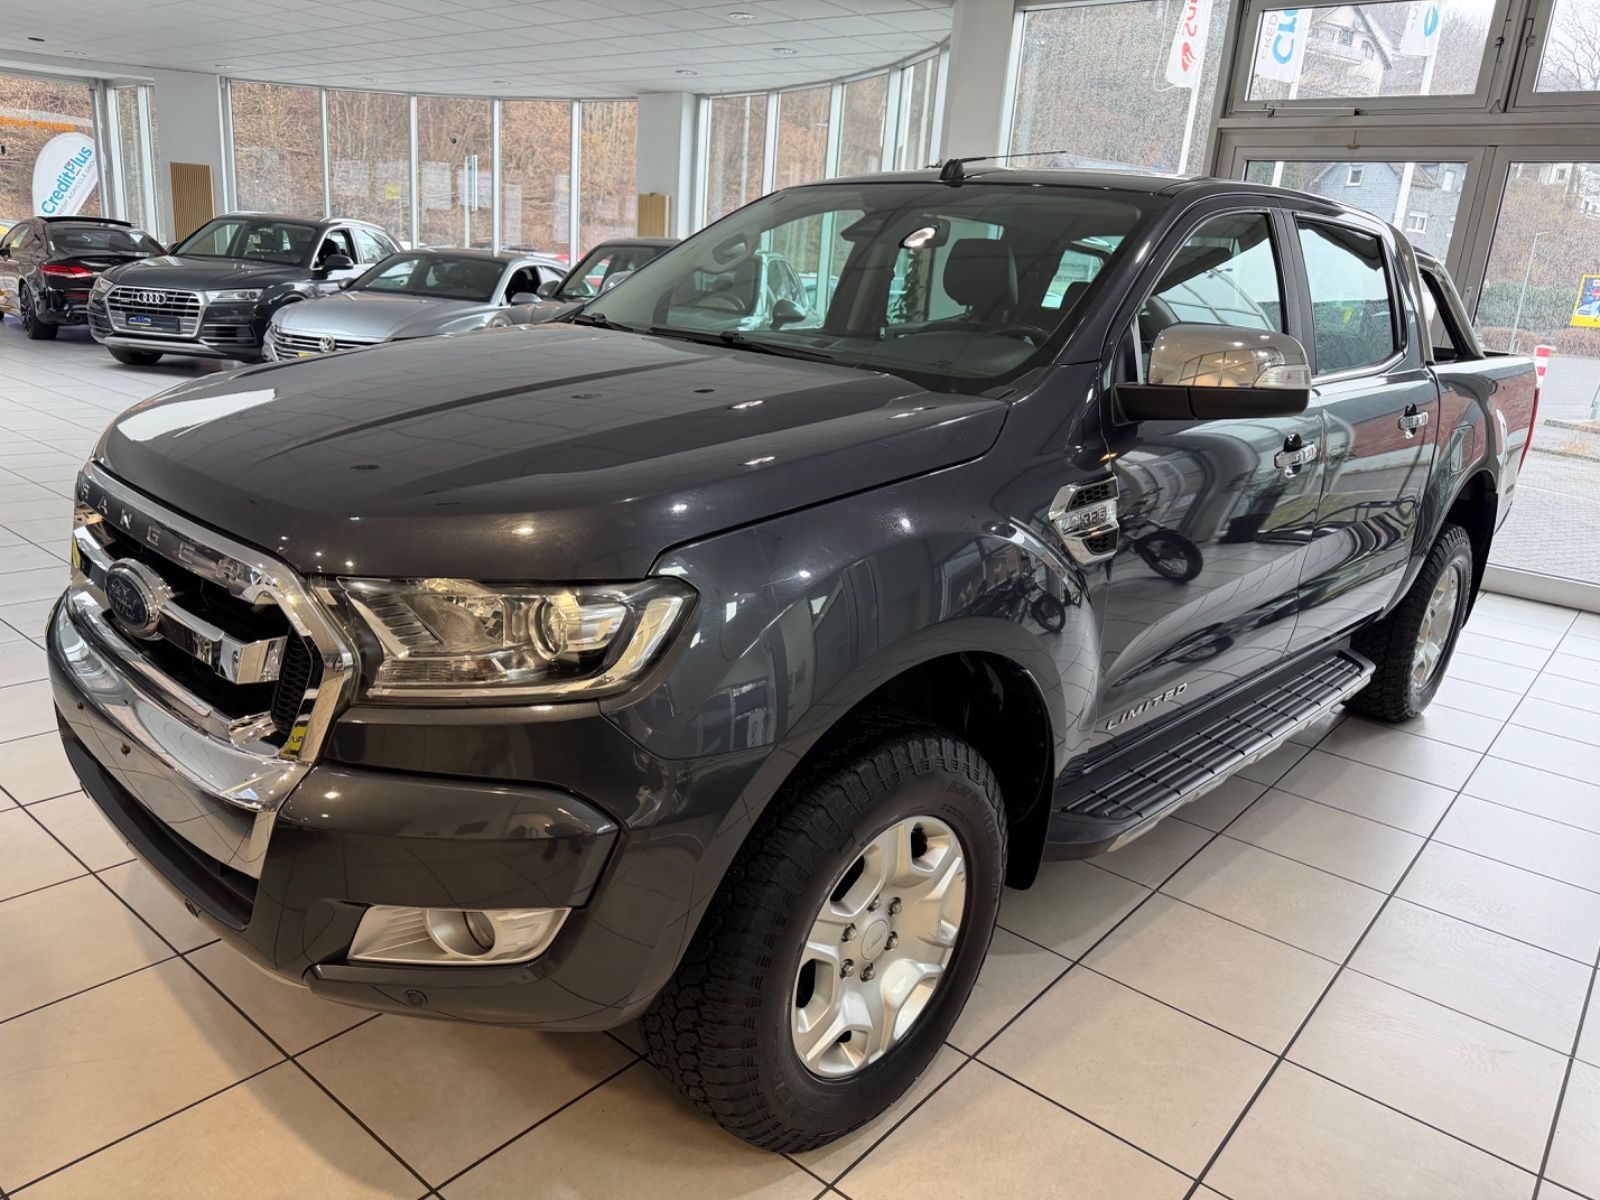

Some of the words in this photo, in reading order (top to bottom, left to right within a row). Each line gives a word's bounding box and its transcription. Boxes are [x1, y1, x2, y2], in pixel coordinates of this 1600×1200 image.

[41, 146, 93, 214] CreditPlus
[81, 482, 243, 584] RANGER
[1105, 682, 1188, 730] LIMITED
